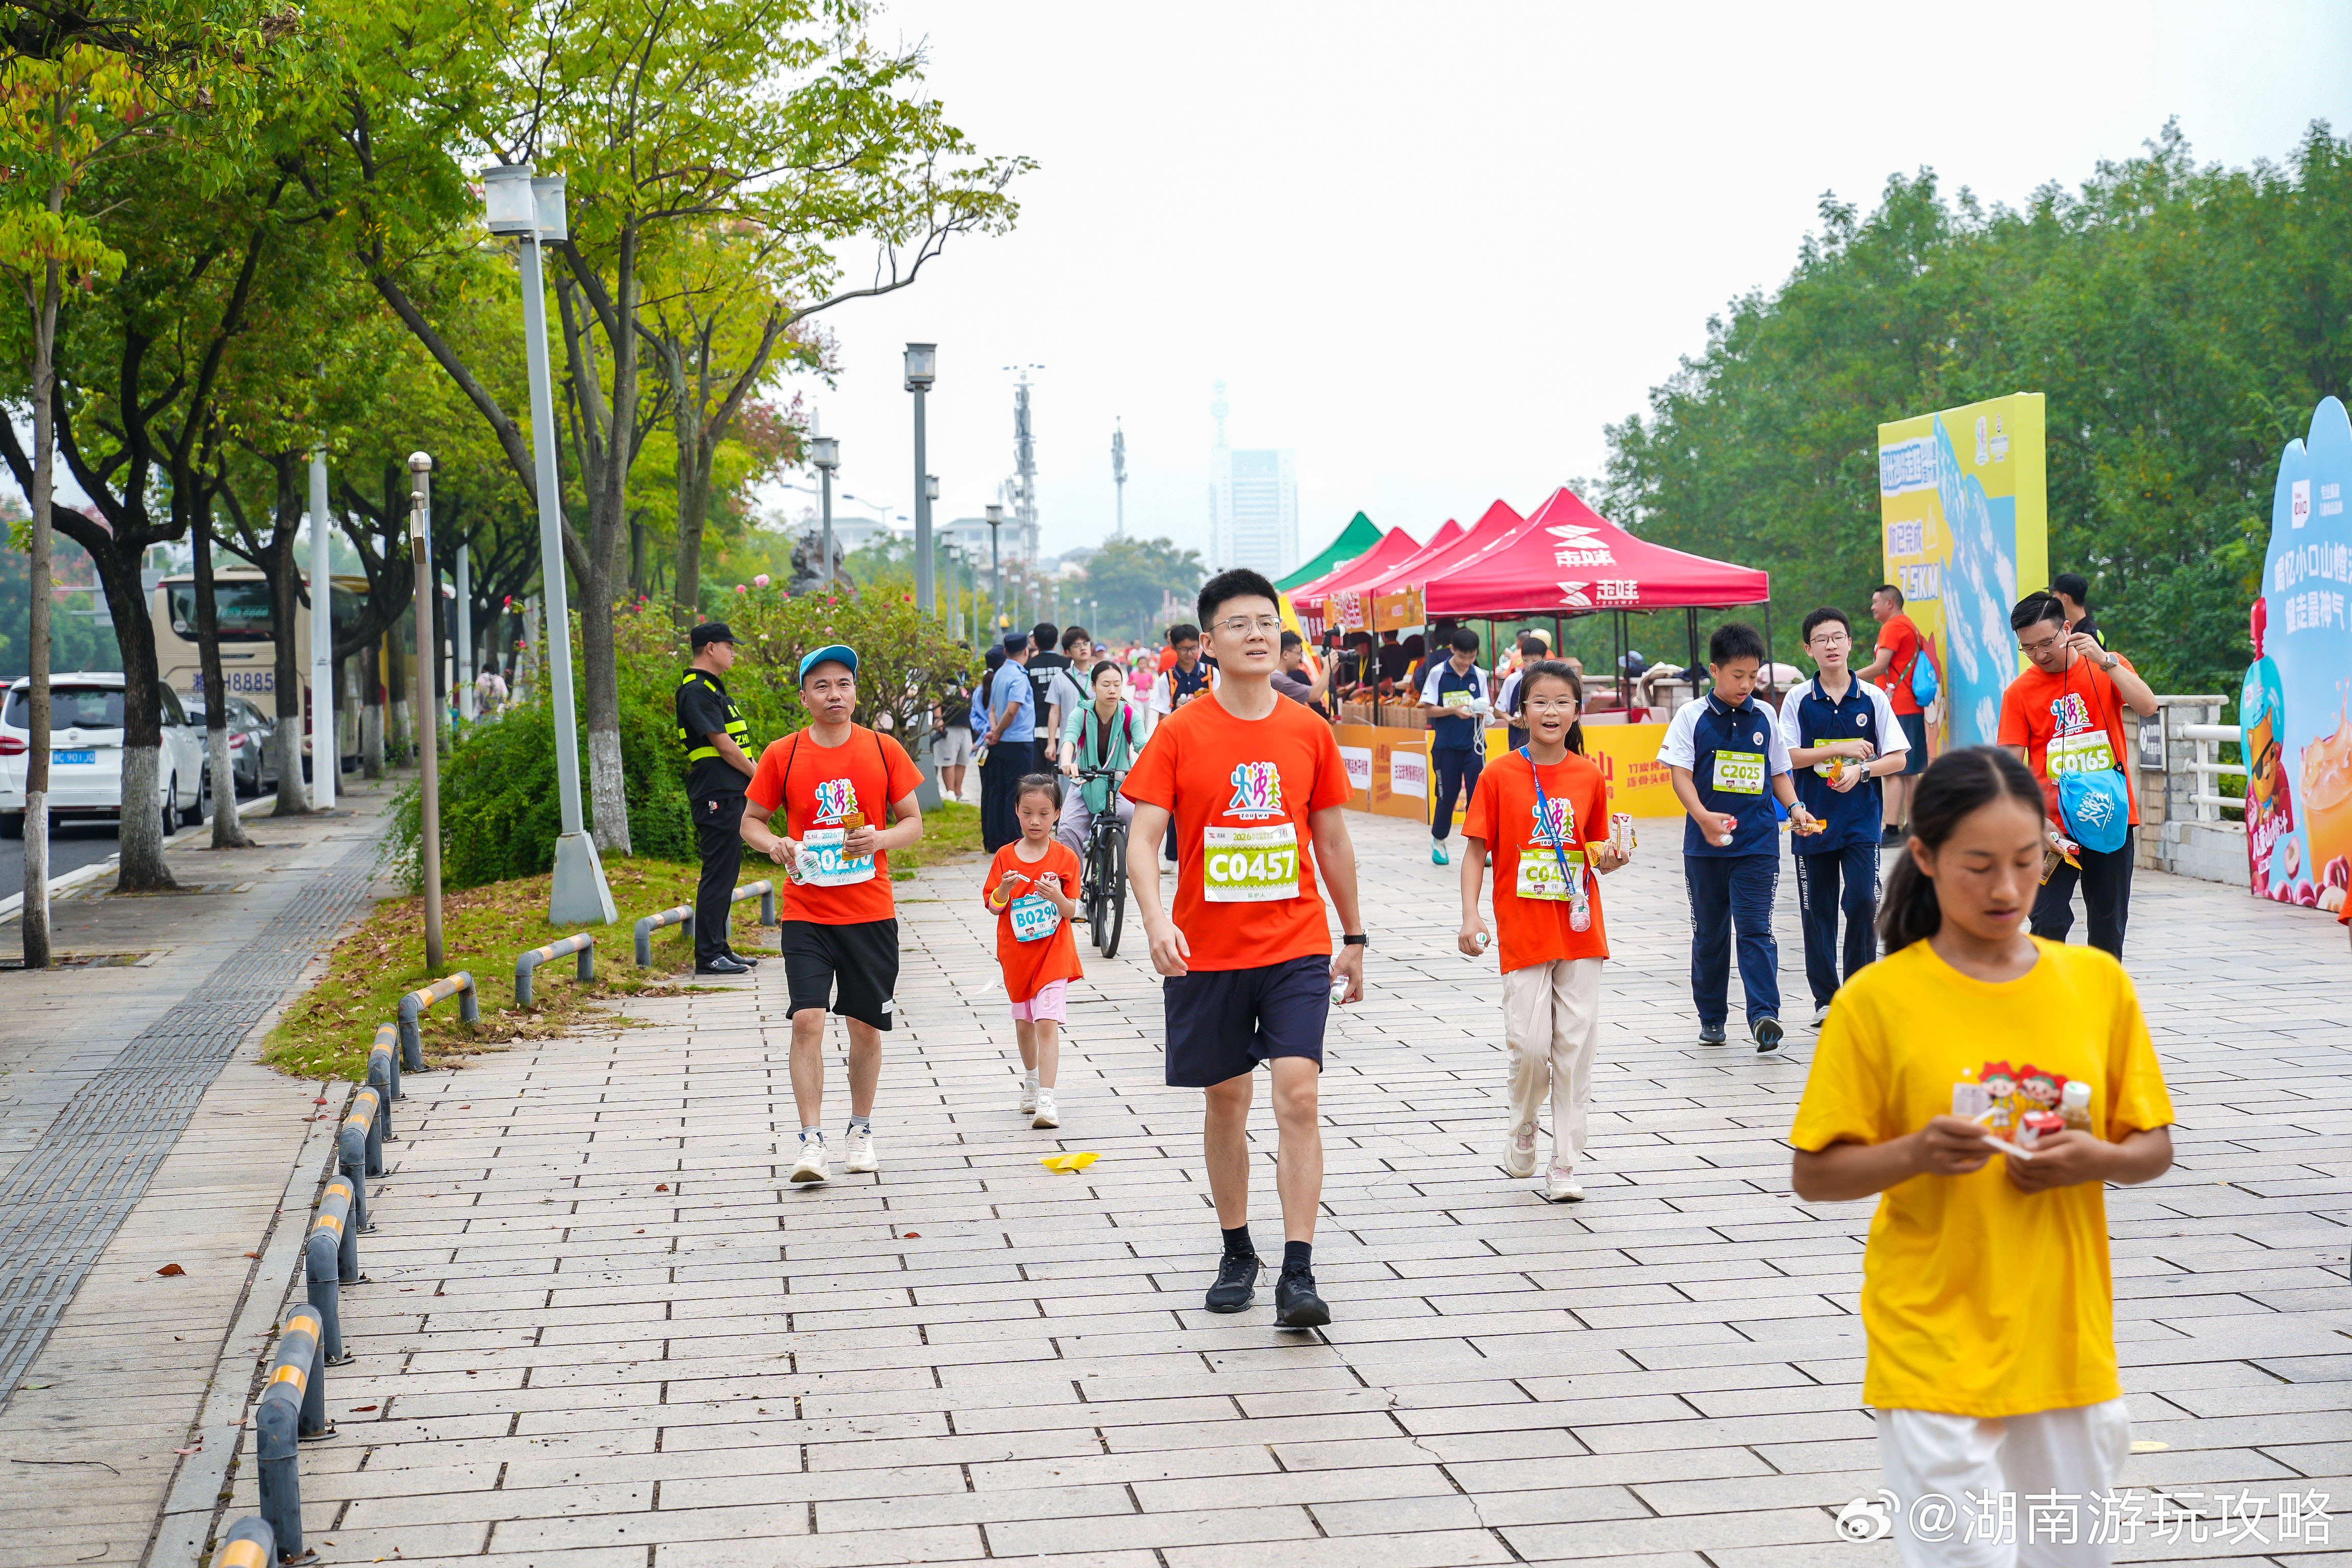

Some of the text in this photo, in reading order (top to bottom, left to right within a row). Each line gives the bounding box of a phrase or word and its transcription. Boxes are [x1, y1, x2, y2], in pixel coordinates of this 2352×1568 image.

[2274, 541, 2352, 593] 喝忆小口山楂
[1721, 765, 1760, 780] C2025
[2051, 749, 2110, 775] C0165
[1209, 849, 1295, 883] C0457
[1526, 866, 1577, 883] C047
[1799, 855, 1807, 880] ANGJUN
[1015, 902, 1057, 928] B0290
